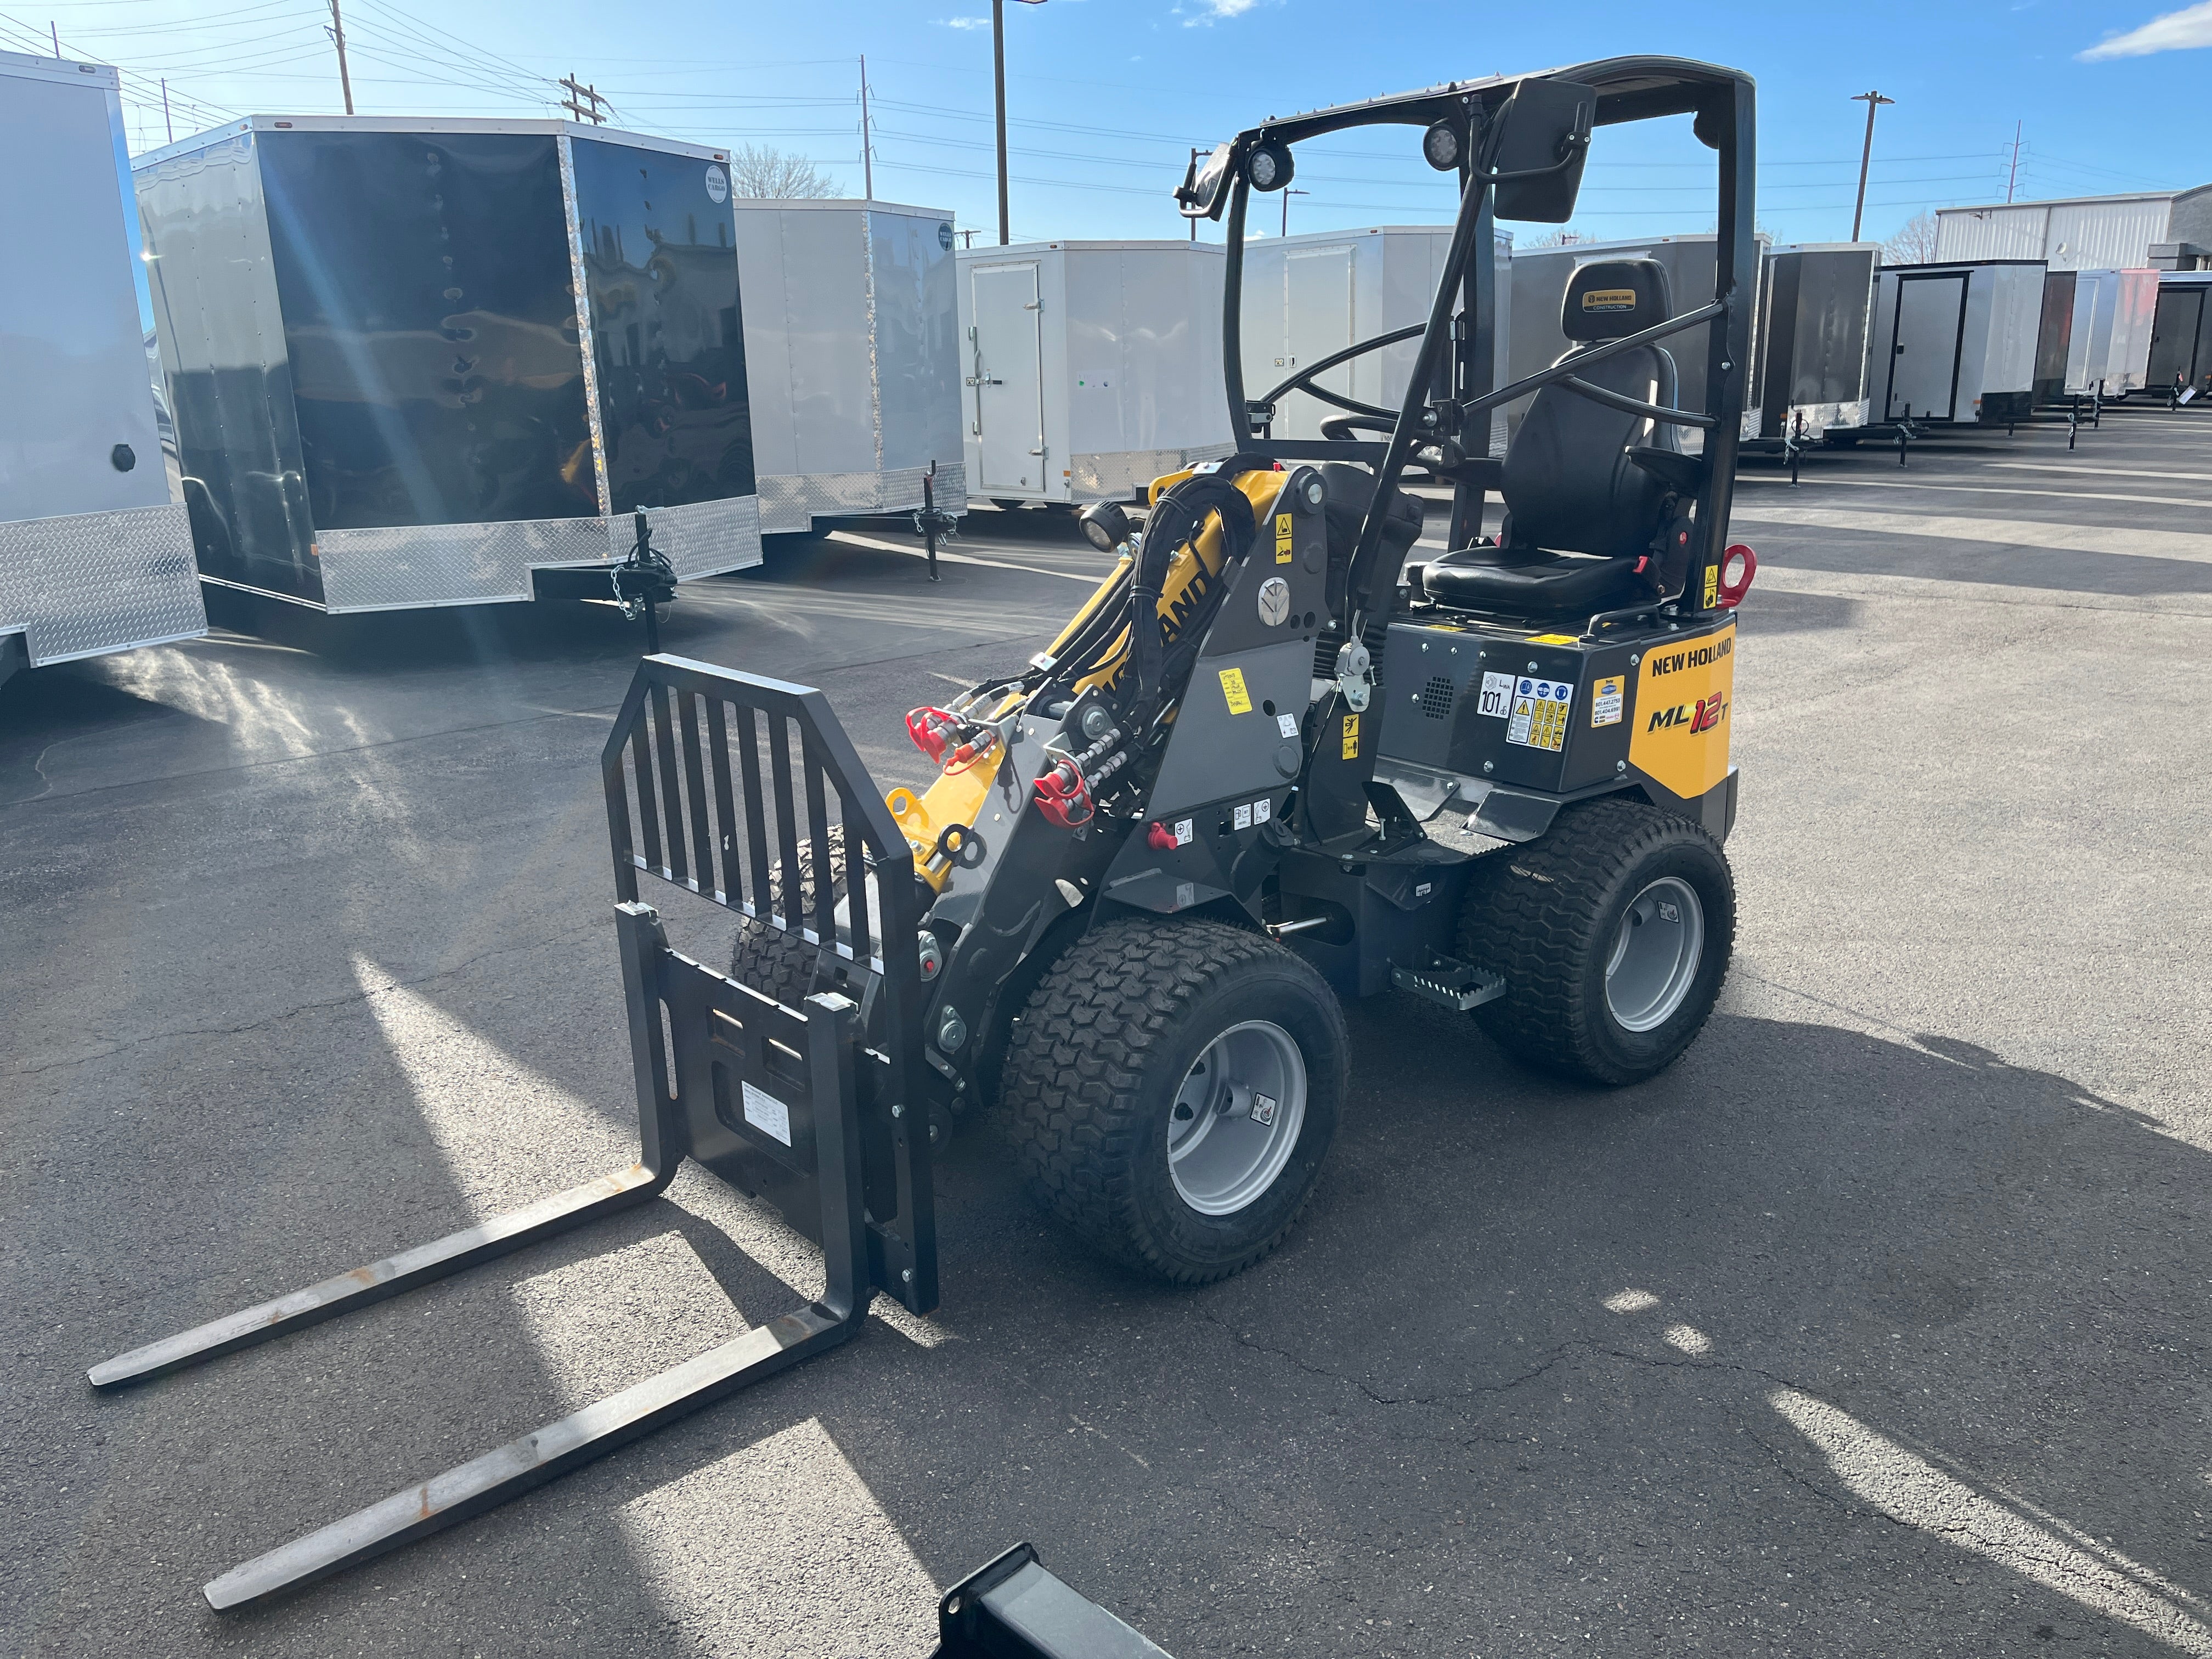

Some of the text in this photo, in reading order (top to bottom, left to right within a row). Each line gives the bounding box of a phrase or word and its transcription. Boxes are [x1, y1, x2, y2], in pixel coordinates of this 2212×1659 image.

[708, 176, 724, 185] WELLS
[1652, 636, 1731, 678] NEW HOLLAND
[1482, 690, 1502, 714] 101
